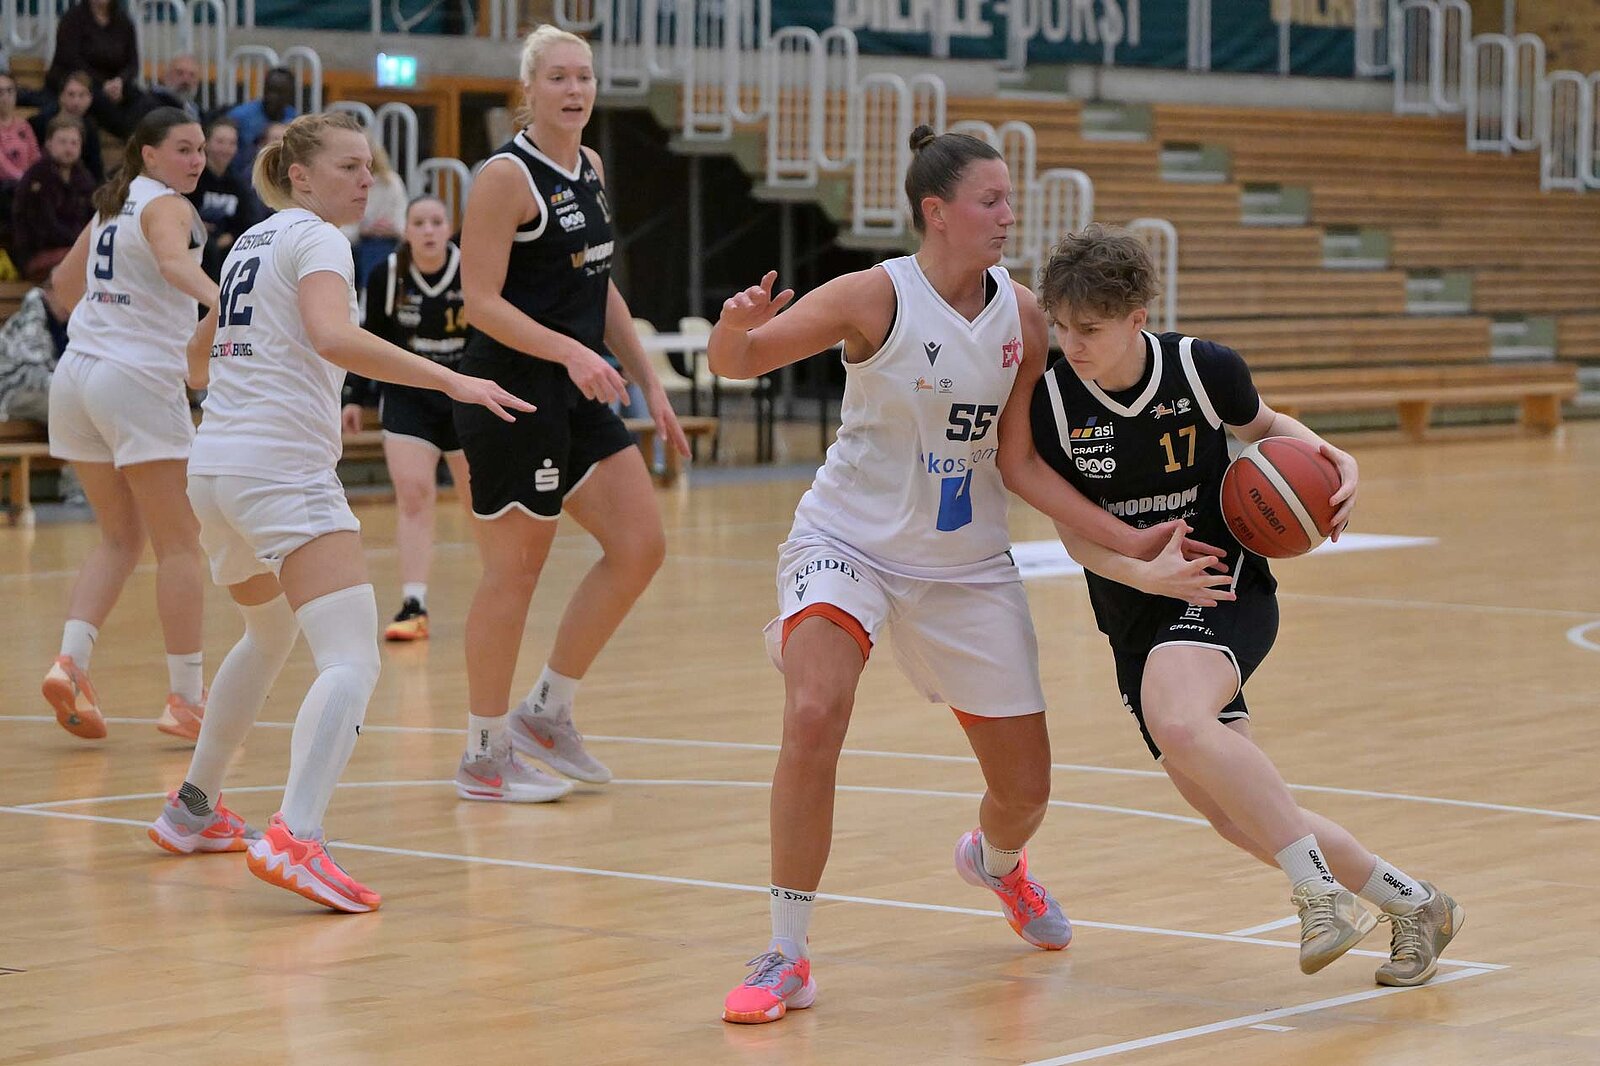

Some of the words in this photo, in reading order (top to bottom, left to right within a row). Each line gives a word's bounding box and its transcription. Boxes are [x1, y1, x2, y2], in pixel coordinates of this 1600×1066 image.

[94, 225, 118, 280] 9
[219, 256, 261, 328] 42
[946, 403, 999, 442] 55
[1094, 422, 1115, 437] asi
[1072, 445, 1105, 455] CRAFT
[1159, 424, 1198, 473] 17
[1075, 457, 1117, 473] EAG
[1101, 484, 1199, 517] MODROM
[1248, 488, 1287, 535] molten
[795, 559, 860, 585] KEIDEL
[1169, 623, 1206, 632] CRAFT
[1308, 849, 1329, 876] CRAFT
[1383, 872, 1406, 892] CRAFT
